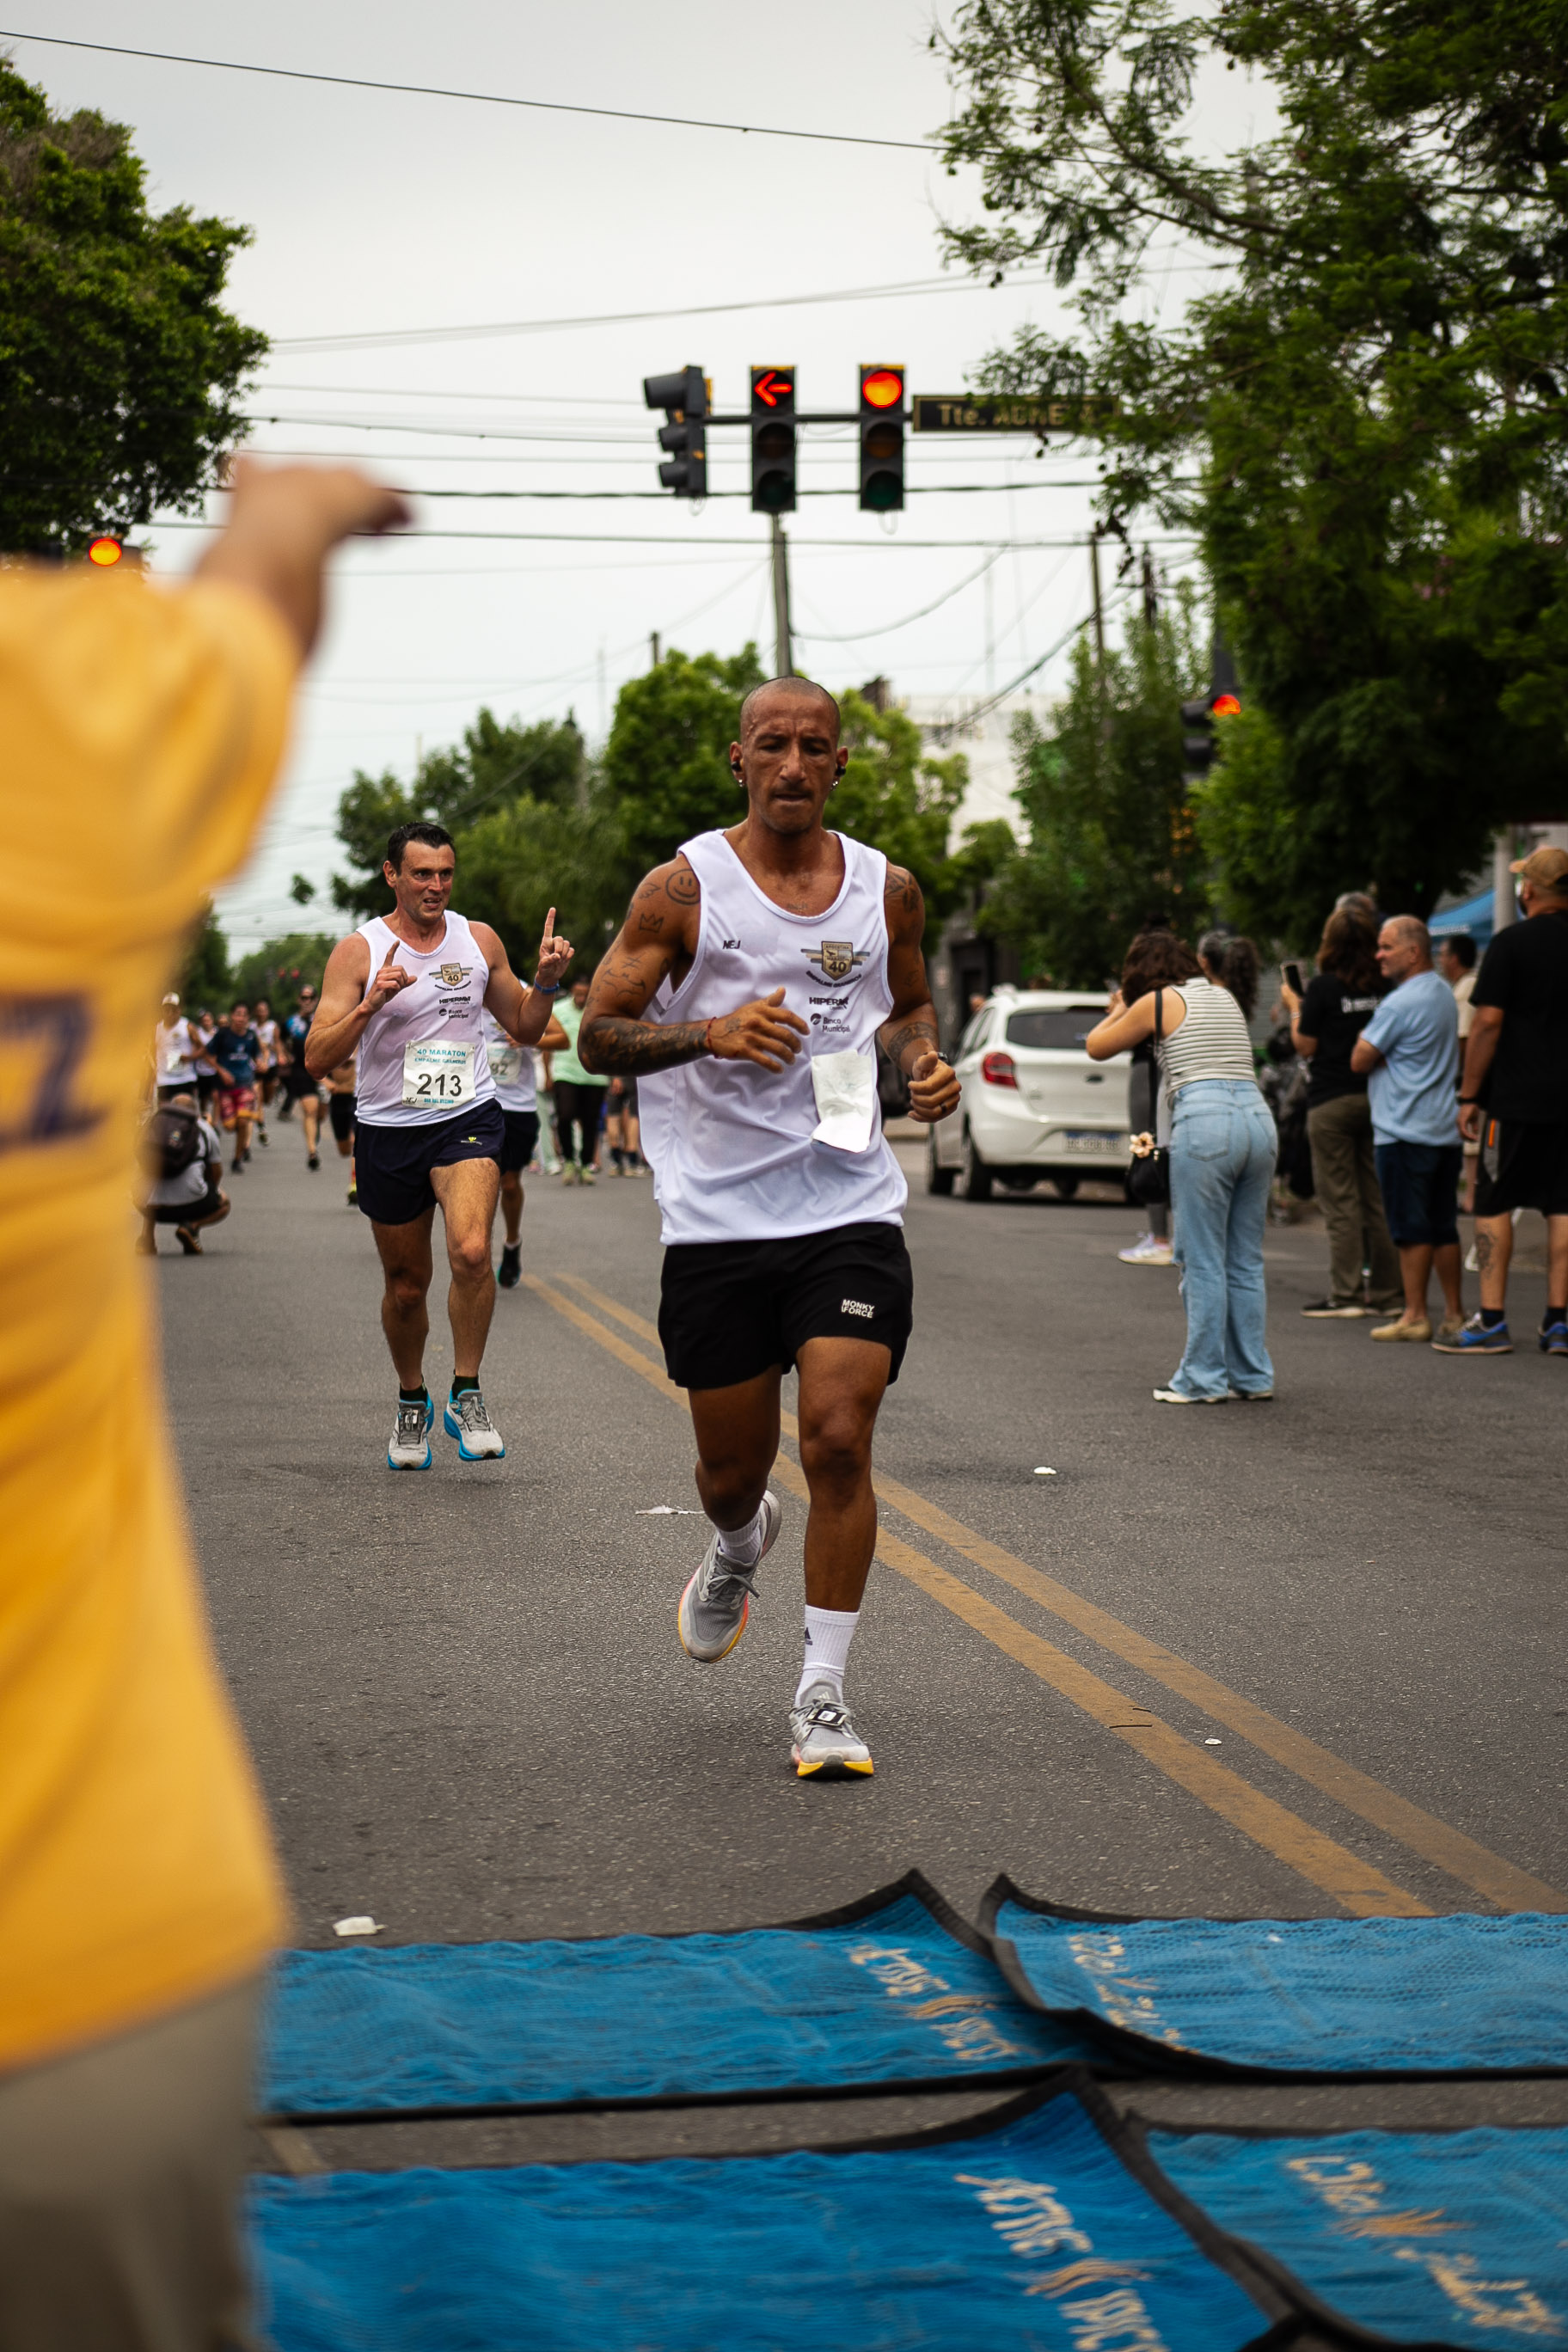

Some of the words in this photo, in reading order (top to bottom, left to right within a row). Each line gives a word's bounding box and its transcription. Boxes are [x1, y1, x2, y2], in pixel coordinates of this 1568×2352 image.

[938, 403, 986, 426] Tte.
[829, 961, 847, 973] 40
[417, 1074, 462, 1096] 213
[842, 1298, 875, 1312] MONKY
